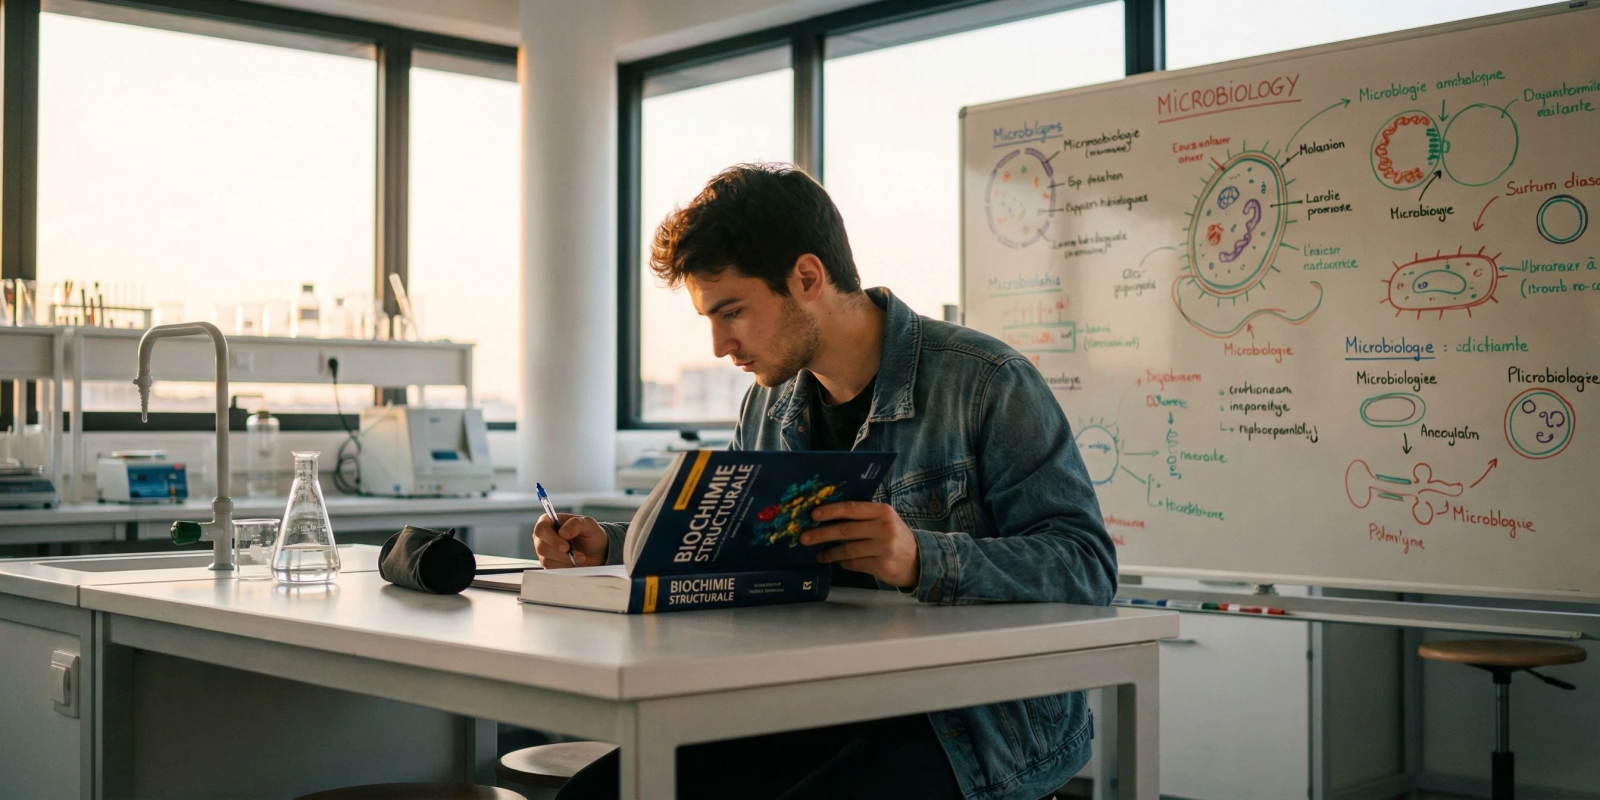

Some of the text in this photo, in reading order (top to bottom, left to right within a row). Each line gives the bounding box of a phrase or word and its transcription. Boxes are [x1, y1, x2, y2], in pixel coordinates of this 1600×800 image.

[1224, 342, 1294, 364] Microbiologie
[1345, 336, 1435, 361] Microbiologie
[673, 464, 737, 564] BIOCHIMIE
[694, 463, 755, 562] STRUCTURALE
[670, 577, 736, 593] BIOCHIMIE
[669, 591, 735, 605] STRUCTURALE
